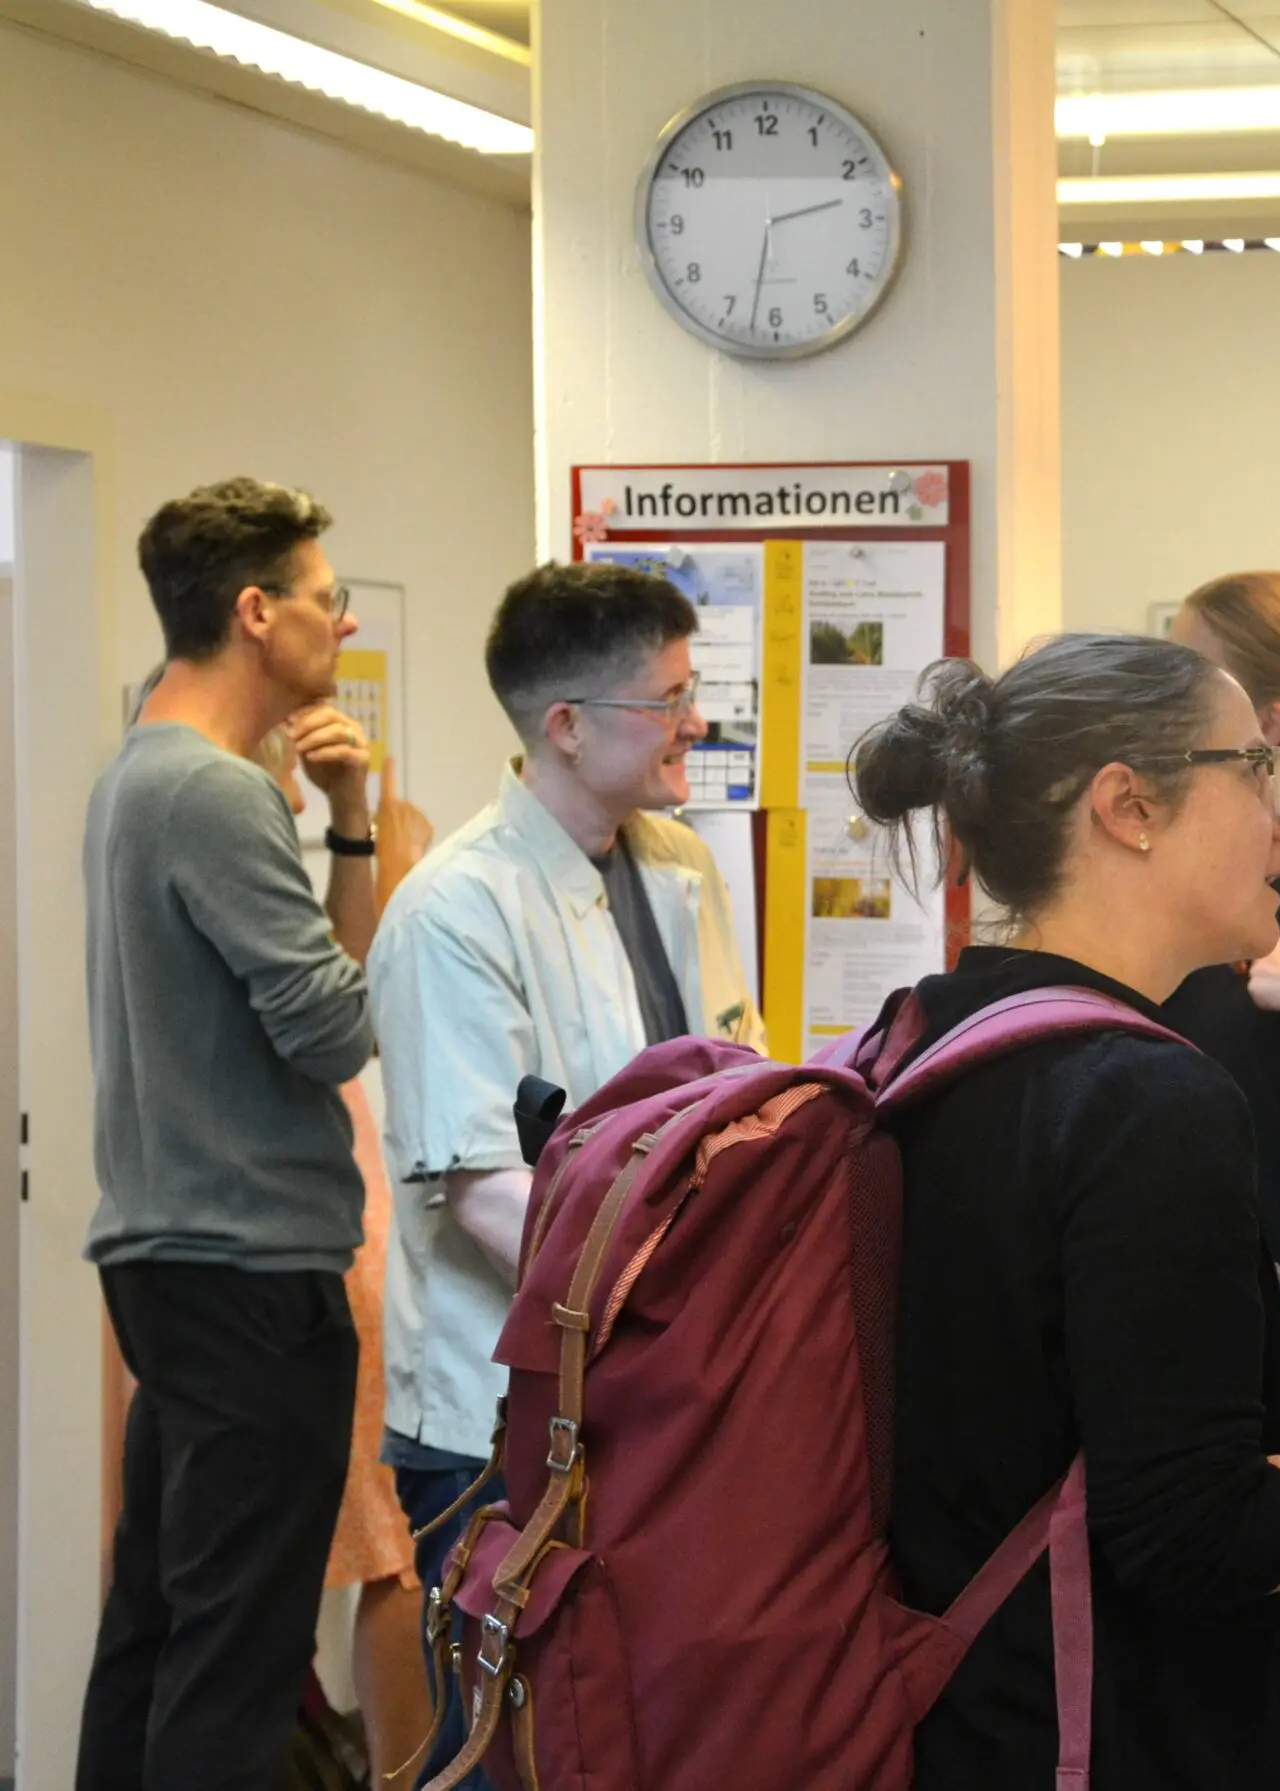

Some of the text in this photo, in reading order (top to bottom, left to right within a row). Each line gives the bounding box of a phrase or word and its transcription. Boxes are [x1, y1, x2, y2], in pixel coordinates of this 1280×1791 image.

[754, 114, 779, 136] 12
[712, 129, 732, 151] 11
[807, 126, 819, 147] 1
[680, 167, 705, 188] 10
[841, 159, 856, 181] 2
[669, 214, 684, 235] 9
[859, 208, 873, 229] 3
[686, 262, 701, 283] 8
[845, 257, 860, 278] 4
[723, 294, 737, 317] 7
[813, 293, 828, 314] 5
[768, 307, 783, 328] 6
[624, 483, 900, 517] Informationen
